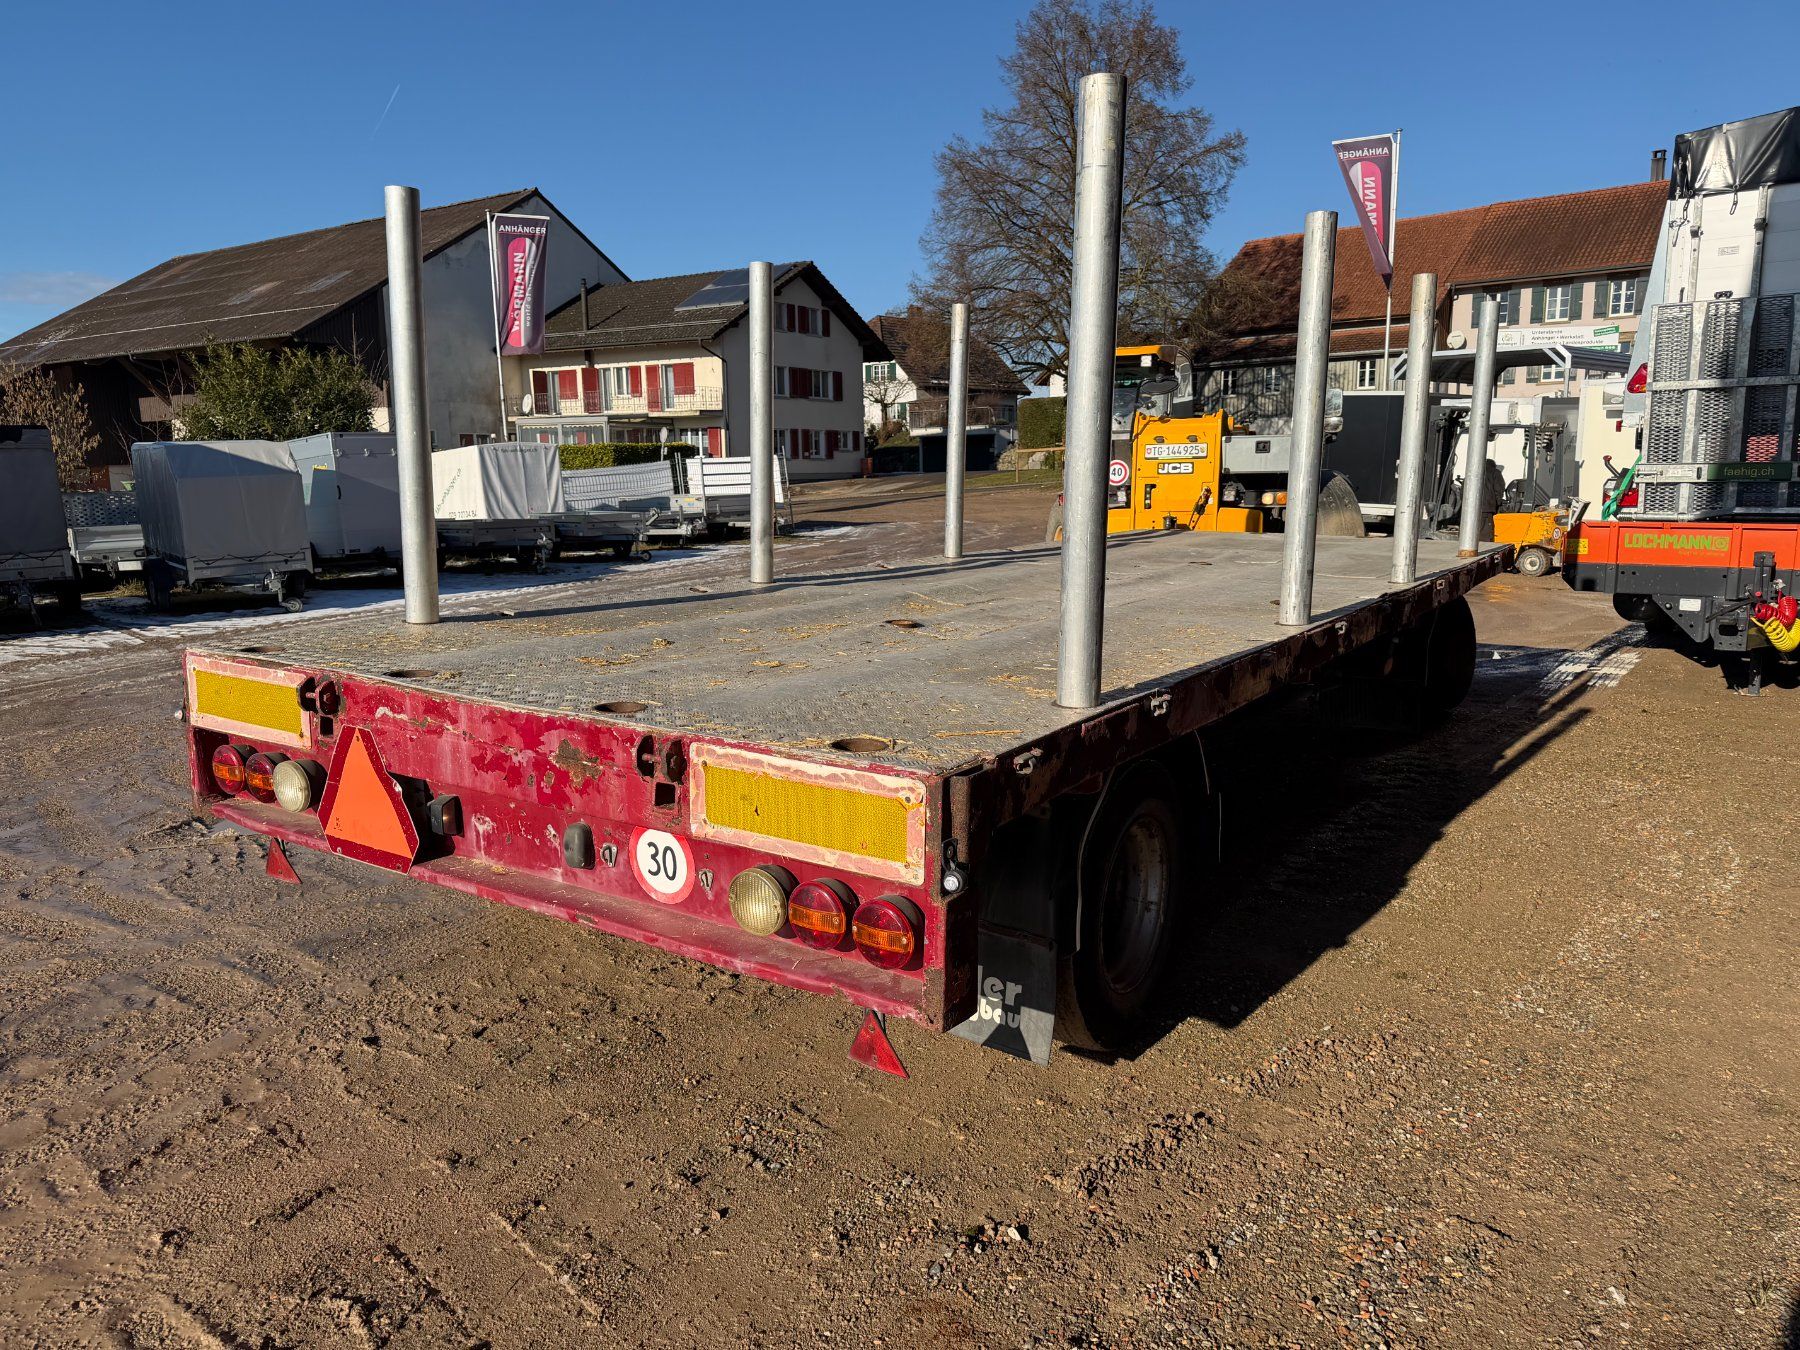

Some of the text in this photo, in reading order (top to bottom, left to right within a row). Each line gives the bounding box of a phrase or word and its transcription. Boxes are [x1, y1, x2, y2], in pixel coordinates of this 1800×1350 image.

[498, 224, 547, 234] ANHÄNGER
[511, 252, 525, 332] WÖRMANN
[1111, 468, 1123, 477] 40
[1158, 463, 1193, 474] JCB
[1724, 466, 1775, 478] faehig.ch
[1624, 533, 1711, 550] LOCHMANN
[647, 841, 677, 881] 30
